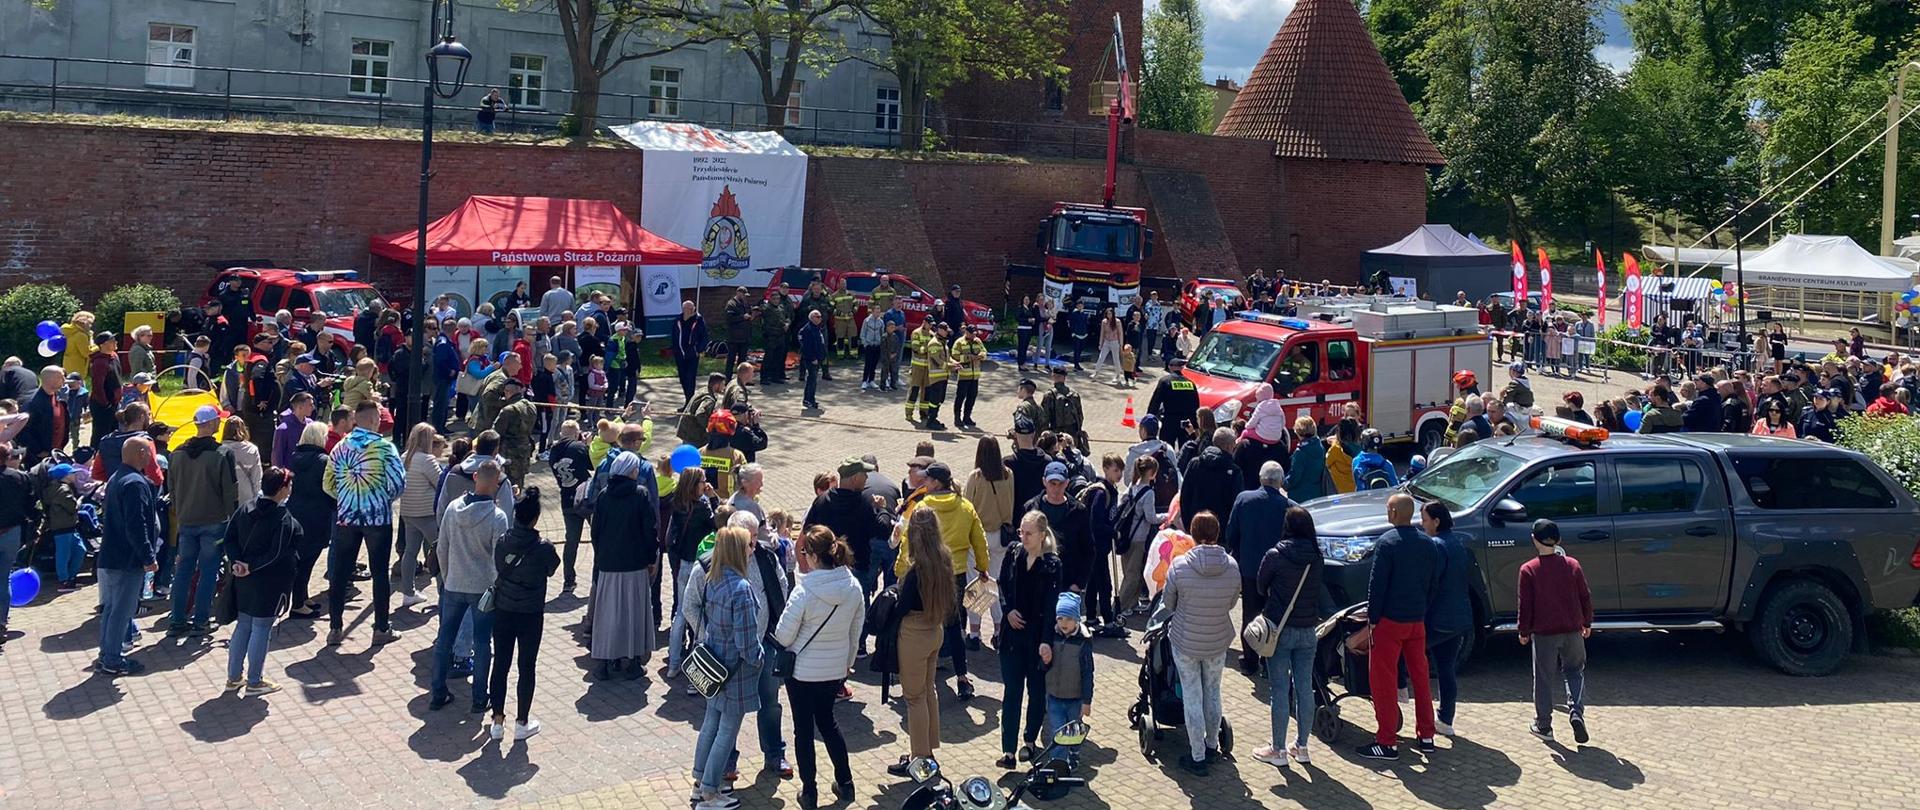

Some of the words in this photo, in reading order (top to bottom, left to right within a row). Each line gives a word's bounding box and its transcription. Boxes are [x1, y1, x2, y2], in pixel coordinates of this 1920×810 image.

[492, 251, 561, 262] Państwowa
[563, 252, 594, 262] Straż
[596, 252, 642, 262] Pożarna
[1758, 275, 1801, 283] BRANIEWSKIE
